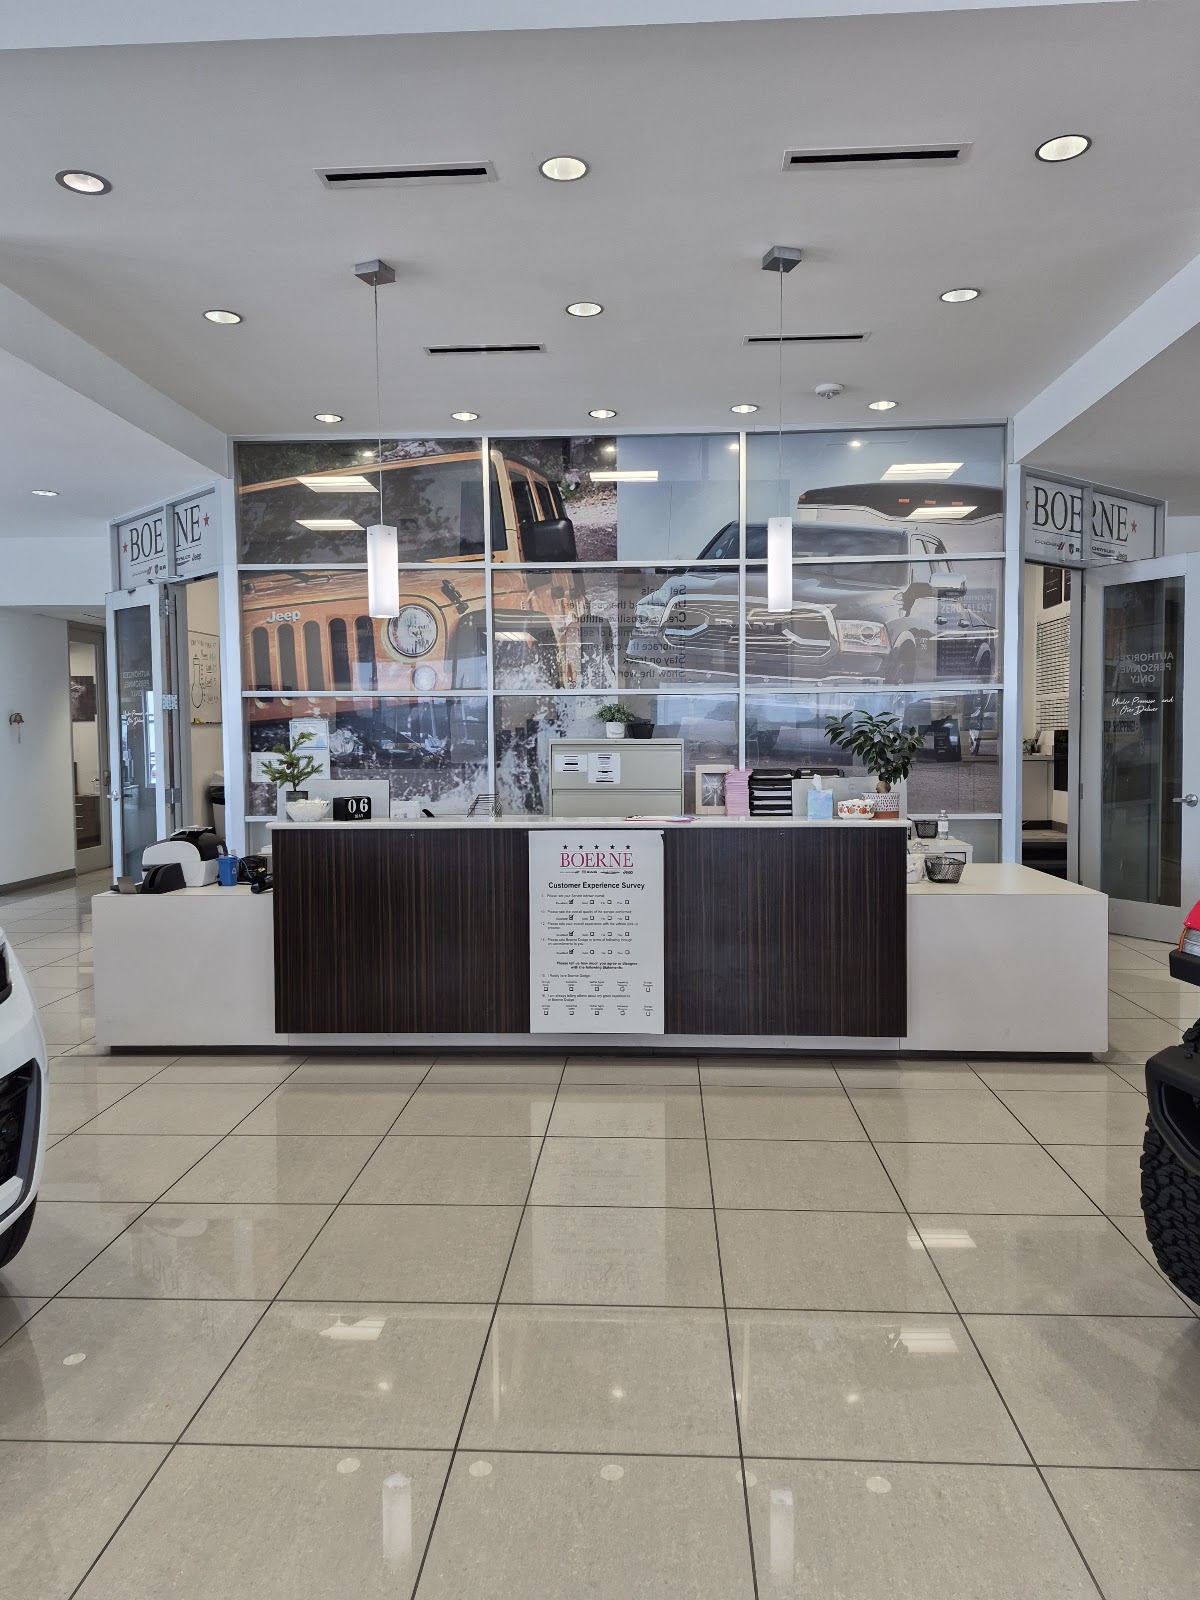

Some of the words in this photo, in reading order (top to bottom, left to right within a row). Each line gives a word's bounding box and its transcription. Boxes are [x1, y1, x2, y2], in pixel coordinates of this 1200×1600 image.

[129, 505, 202, 562] BOENE
[266, 611, 301, 623] Jeep
[560, 852, 634, 868] BOERNE
[582, 882, 620, 890] Experience
[621, 882, 645, 891] Survey
